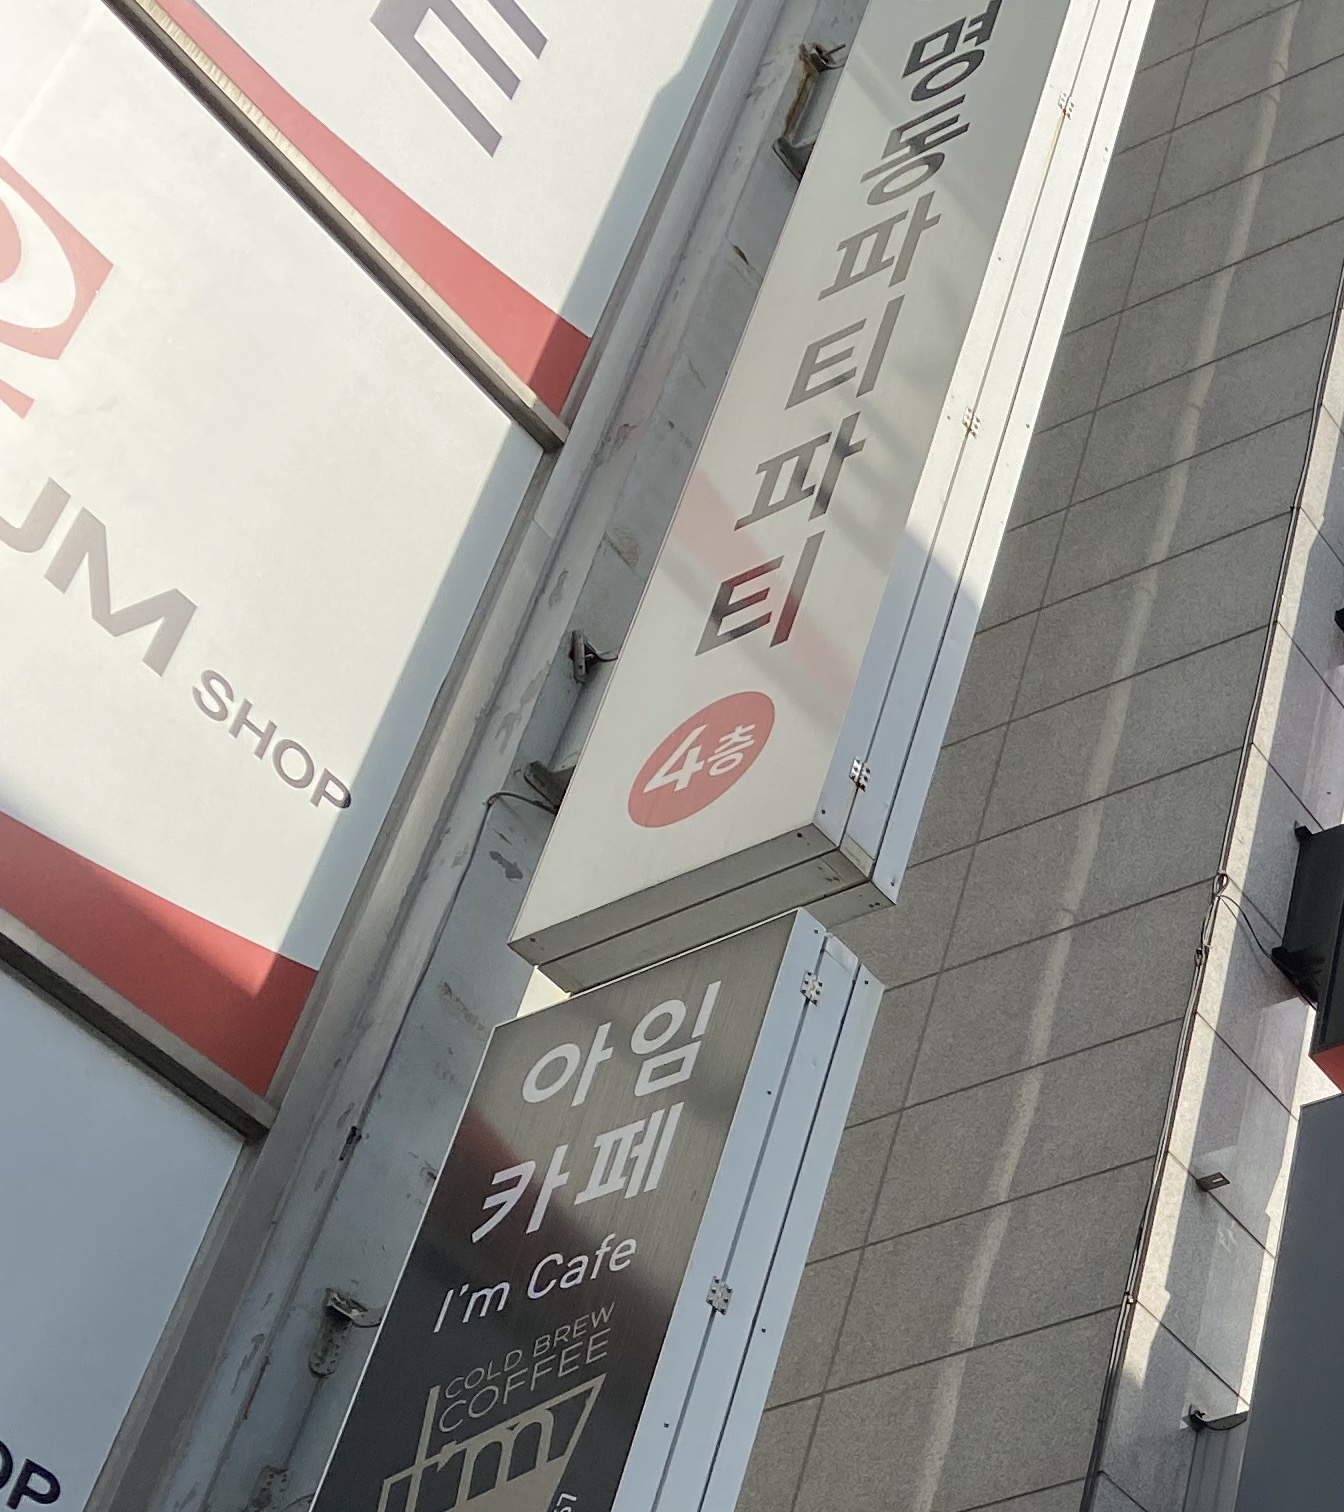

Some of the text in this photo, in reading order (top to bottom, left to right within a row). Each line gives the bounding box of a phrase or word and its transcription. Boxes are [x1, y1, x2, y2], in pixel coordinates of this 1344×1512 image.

[191, 667, 352, 811] SHOP
[642, 723, 756, 793] 4층
[521, 979, 723, 1109] 아임
[470, 1100, 687, 1245] 카페
[432, 1231, 638, 1334] I'm Cafe
[438, 1326, 613, 1434] COFFEE
[444, 1300, 616, 1400] COLD BREW
